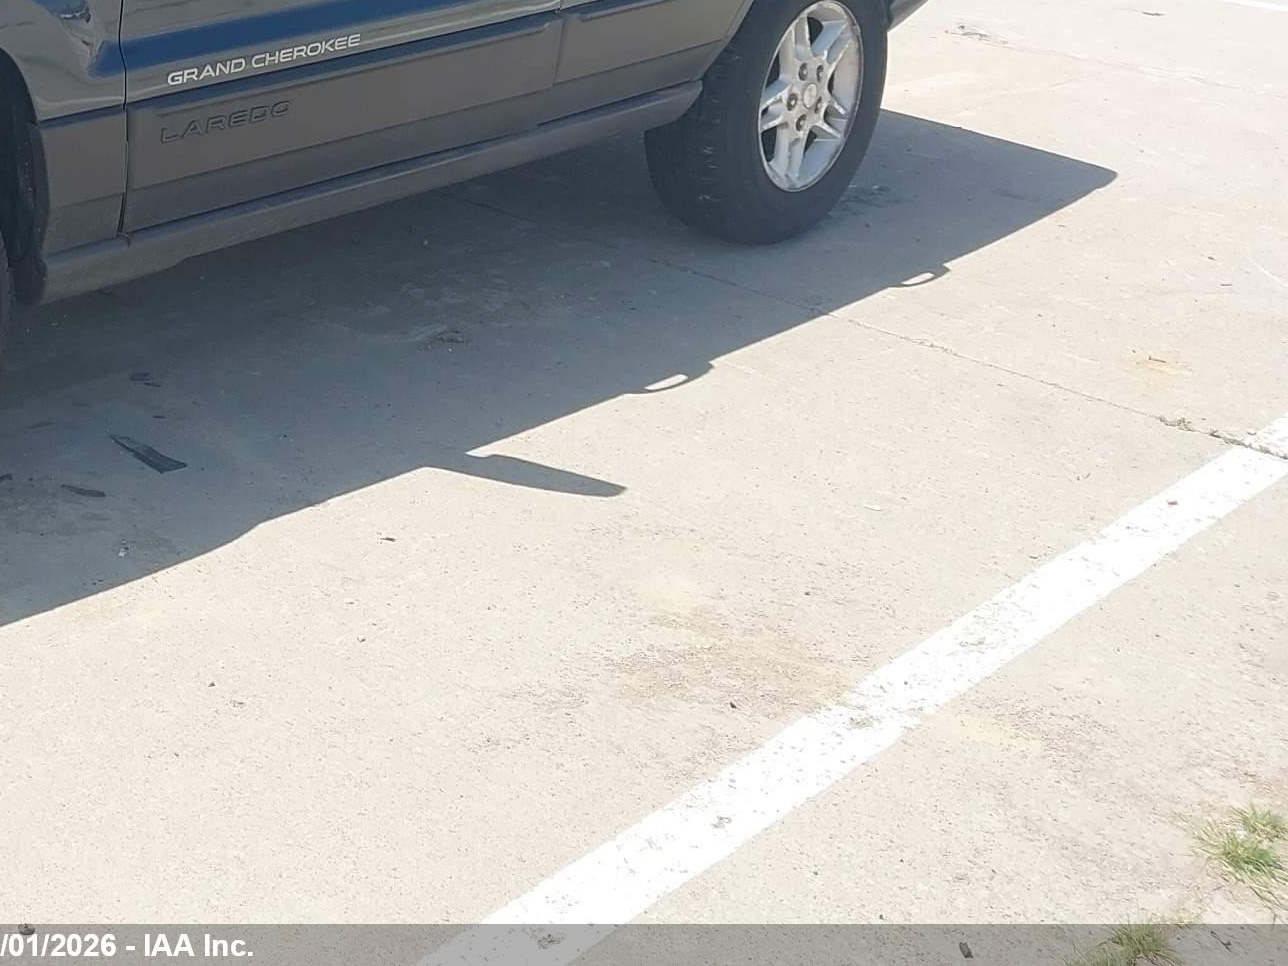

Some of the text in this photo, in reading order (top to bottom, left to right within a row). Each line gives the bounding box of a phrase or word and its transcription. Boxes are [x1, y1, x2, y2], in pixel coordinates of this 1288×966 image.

[167, 33, 361, 85] GRAND CHEROKEE
[160, 100, 292, 145] LAREDO
